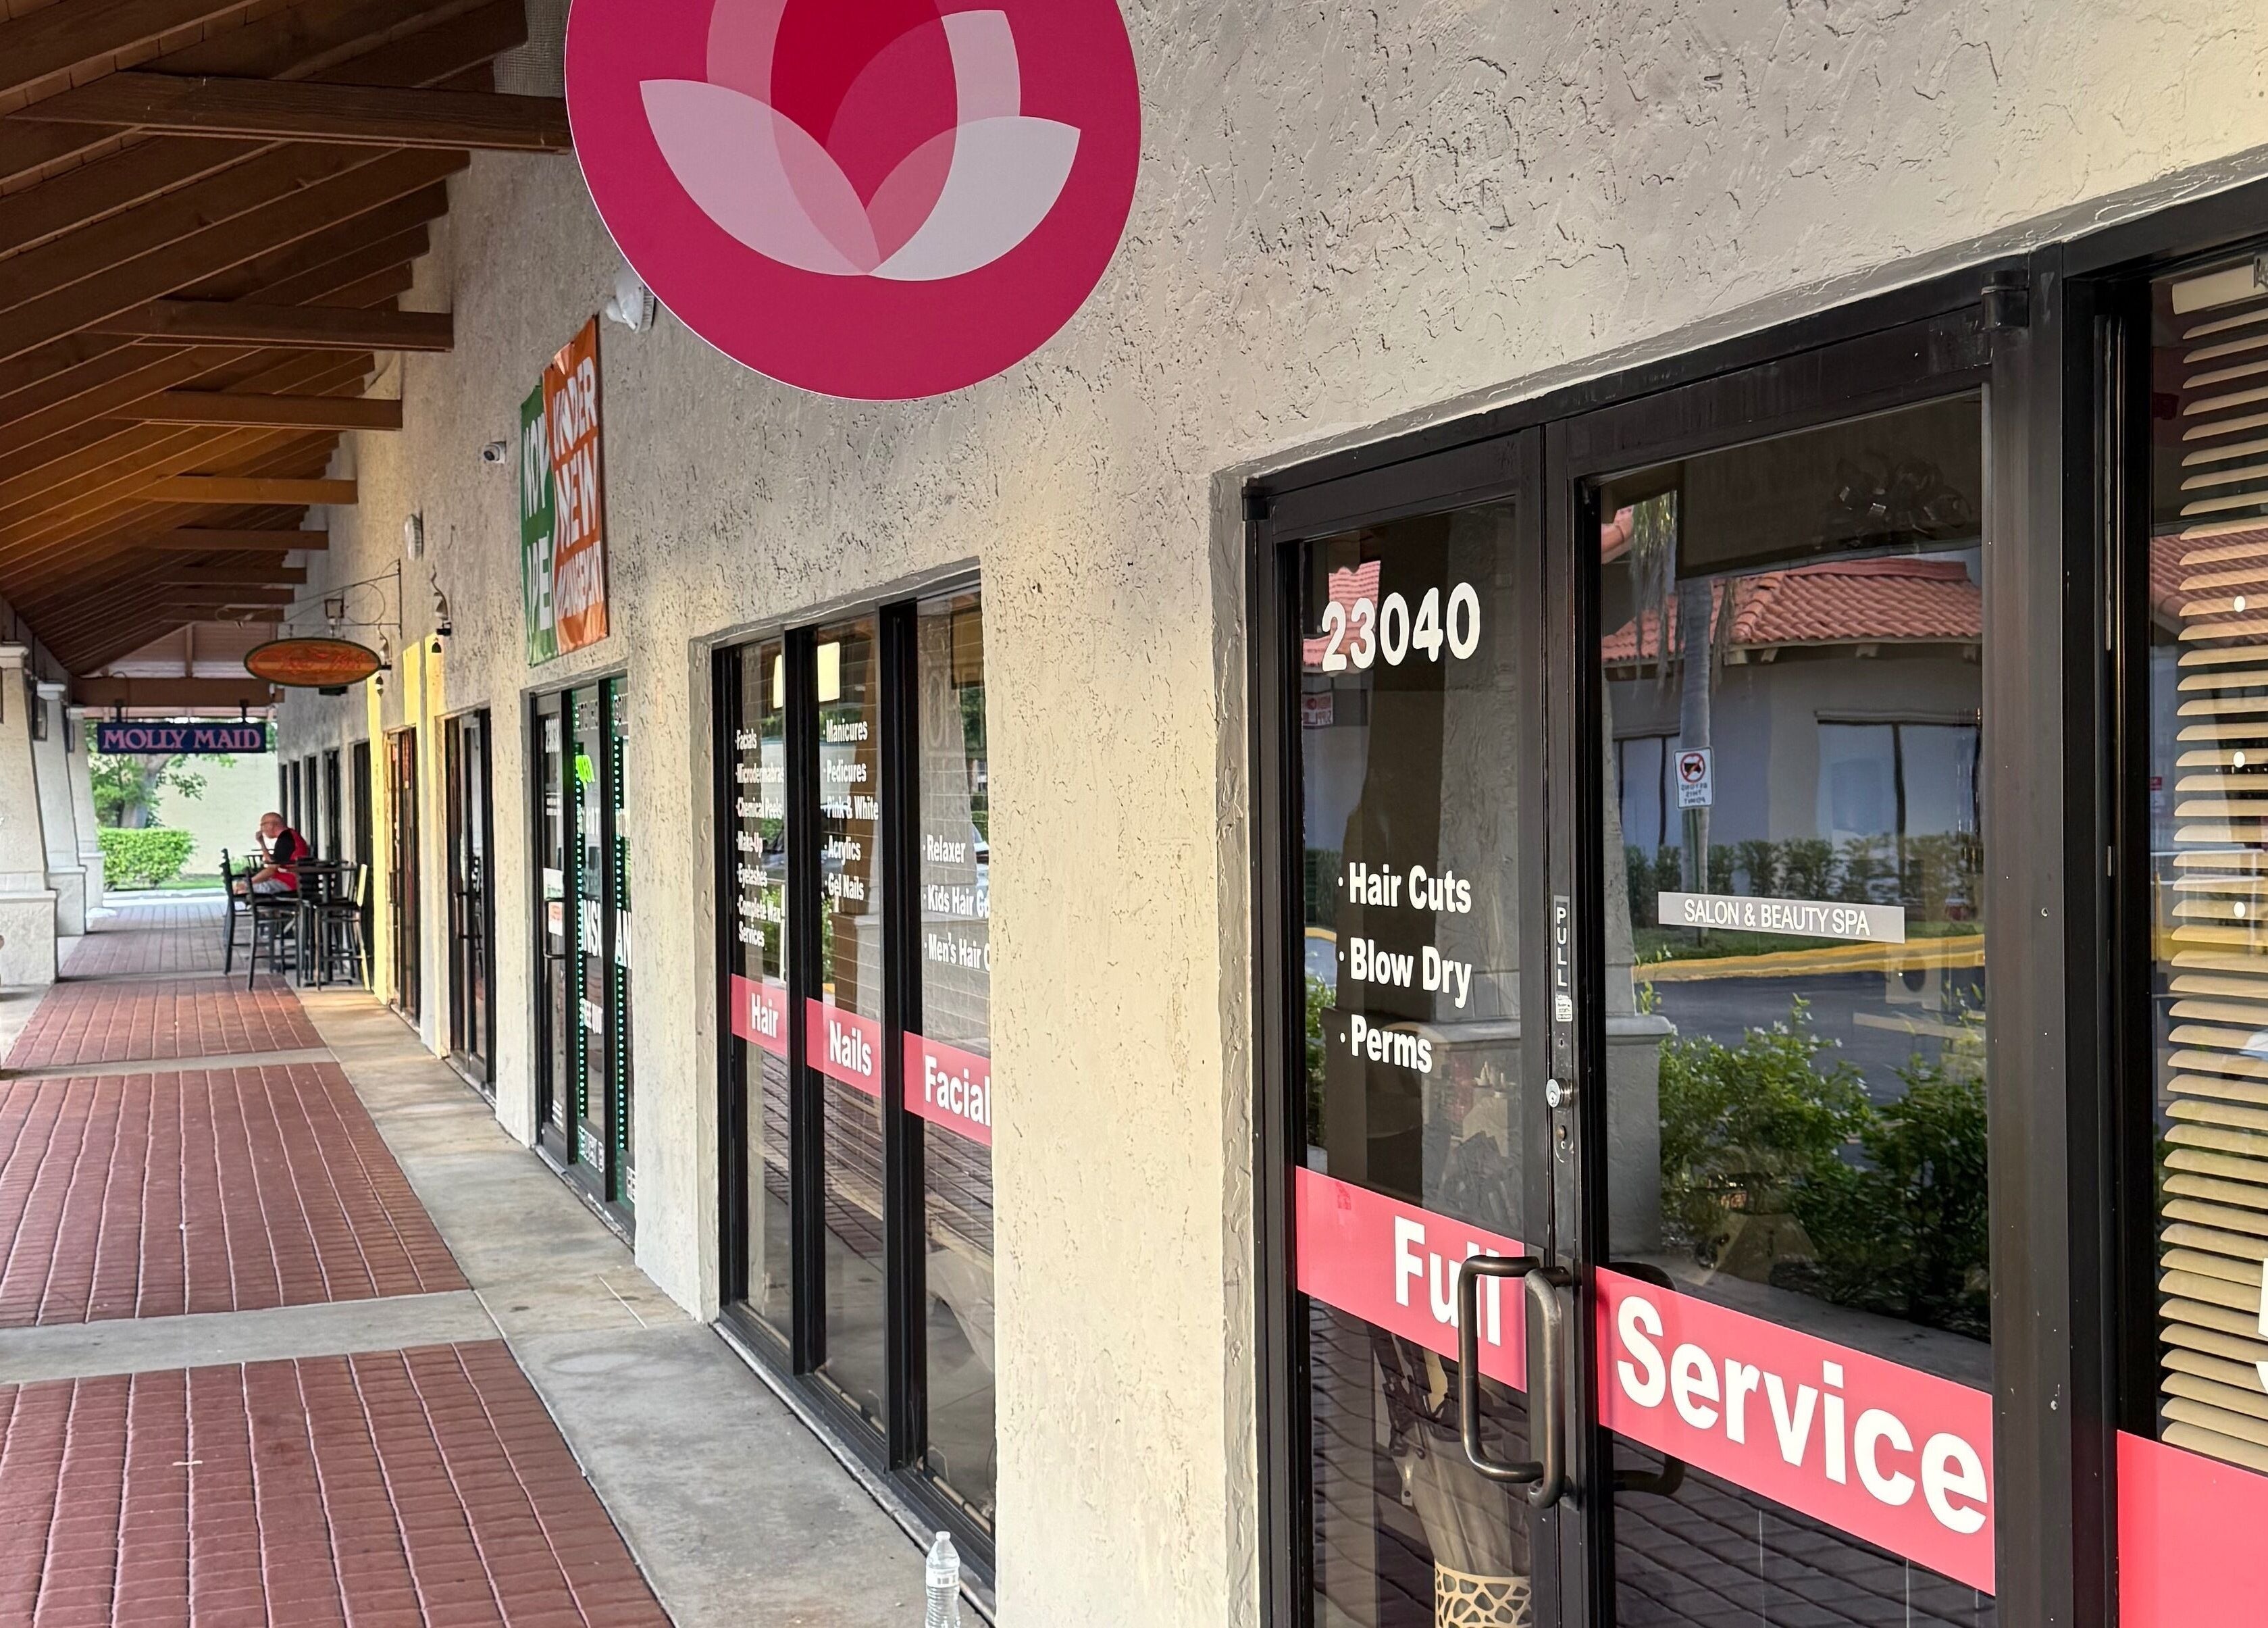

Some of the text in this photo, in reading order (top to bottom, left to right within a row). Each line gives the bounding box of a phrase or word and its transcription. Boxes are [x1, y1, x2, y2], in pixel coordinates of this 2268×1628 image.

[553, 356, 597, 461] UNDER
[555, 436, 597, 553] NEW
[1321, 582, 1480, 671] 23040
[103, 729, 261, 749] MOLLY MAID
[736, 728, 757, 750] Facials
[826, 718, 868, 742] Manicures
[826, 759, 867, 782] Pedicures
[827, 794, 879, 820] Pink & White
[827, 835, 861, 865] Acrylics
[927, 834, 966, 863] Relaxer
[738, 863, 768, 888] Eyelashes
[828, 872, 865, 900] Gel Nails
[1349, 862, 1472, 914] Hair Cuts
[927, 884, 950, 913] Kids
[952, 886, 975, 917] Hair
[1684, 898, 1871, 937] SALON & BEAUTY SPA
[738, 921, 765, 948] Services
[928, 932, 957, 965] Men's
[958, 938, 982, 969] Hair
[1556, 907, 1568, 987] PULL
[1350, 937, 1472, 1009] Blow Dry
[750, 992, 779, 1039] Hair
[829, 1019, 873, 1077] Nails
[1351, 1014, 1433, 1074] Perms
[924, 1054, 991, 1127] Facial
[1616, 1294, 1988, 1535] Service
